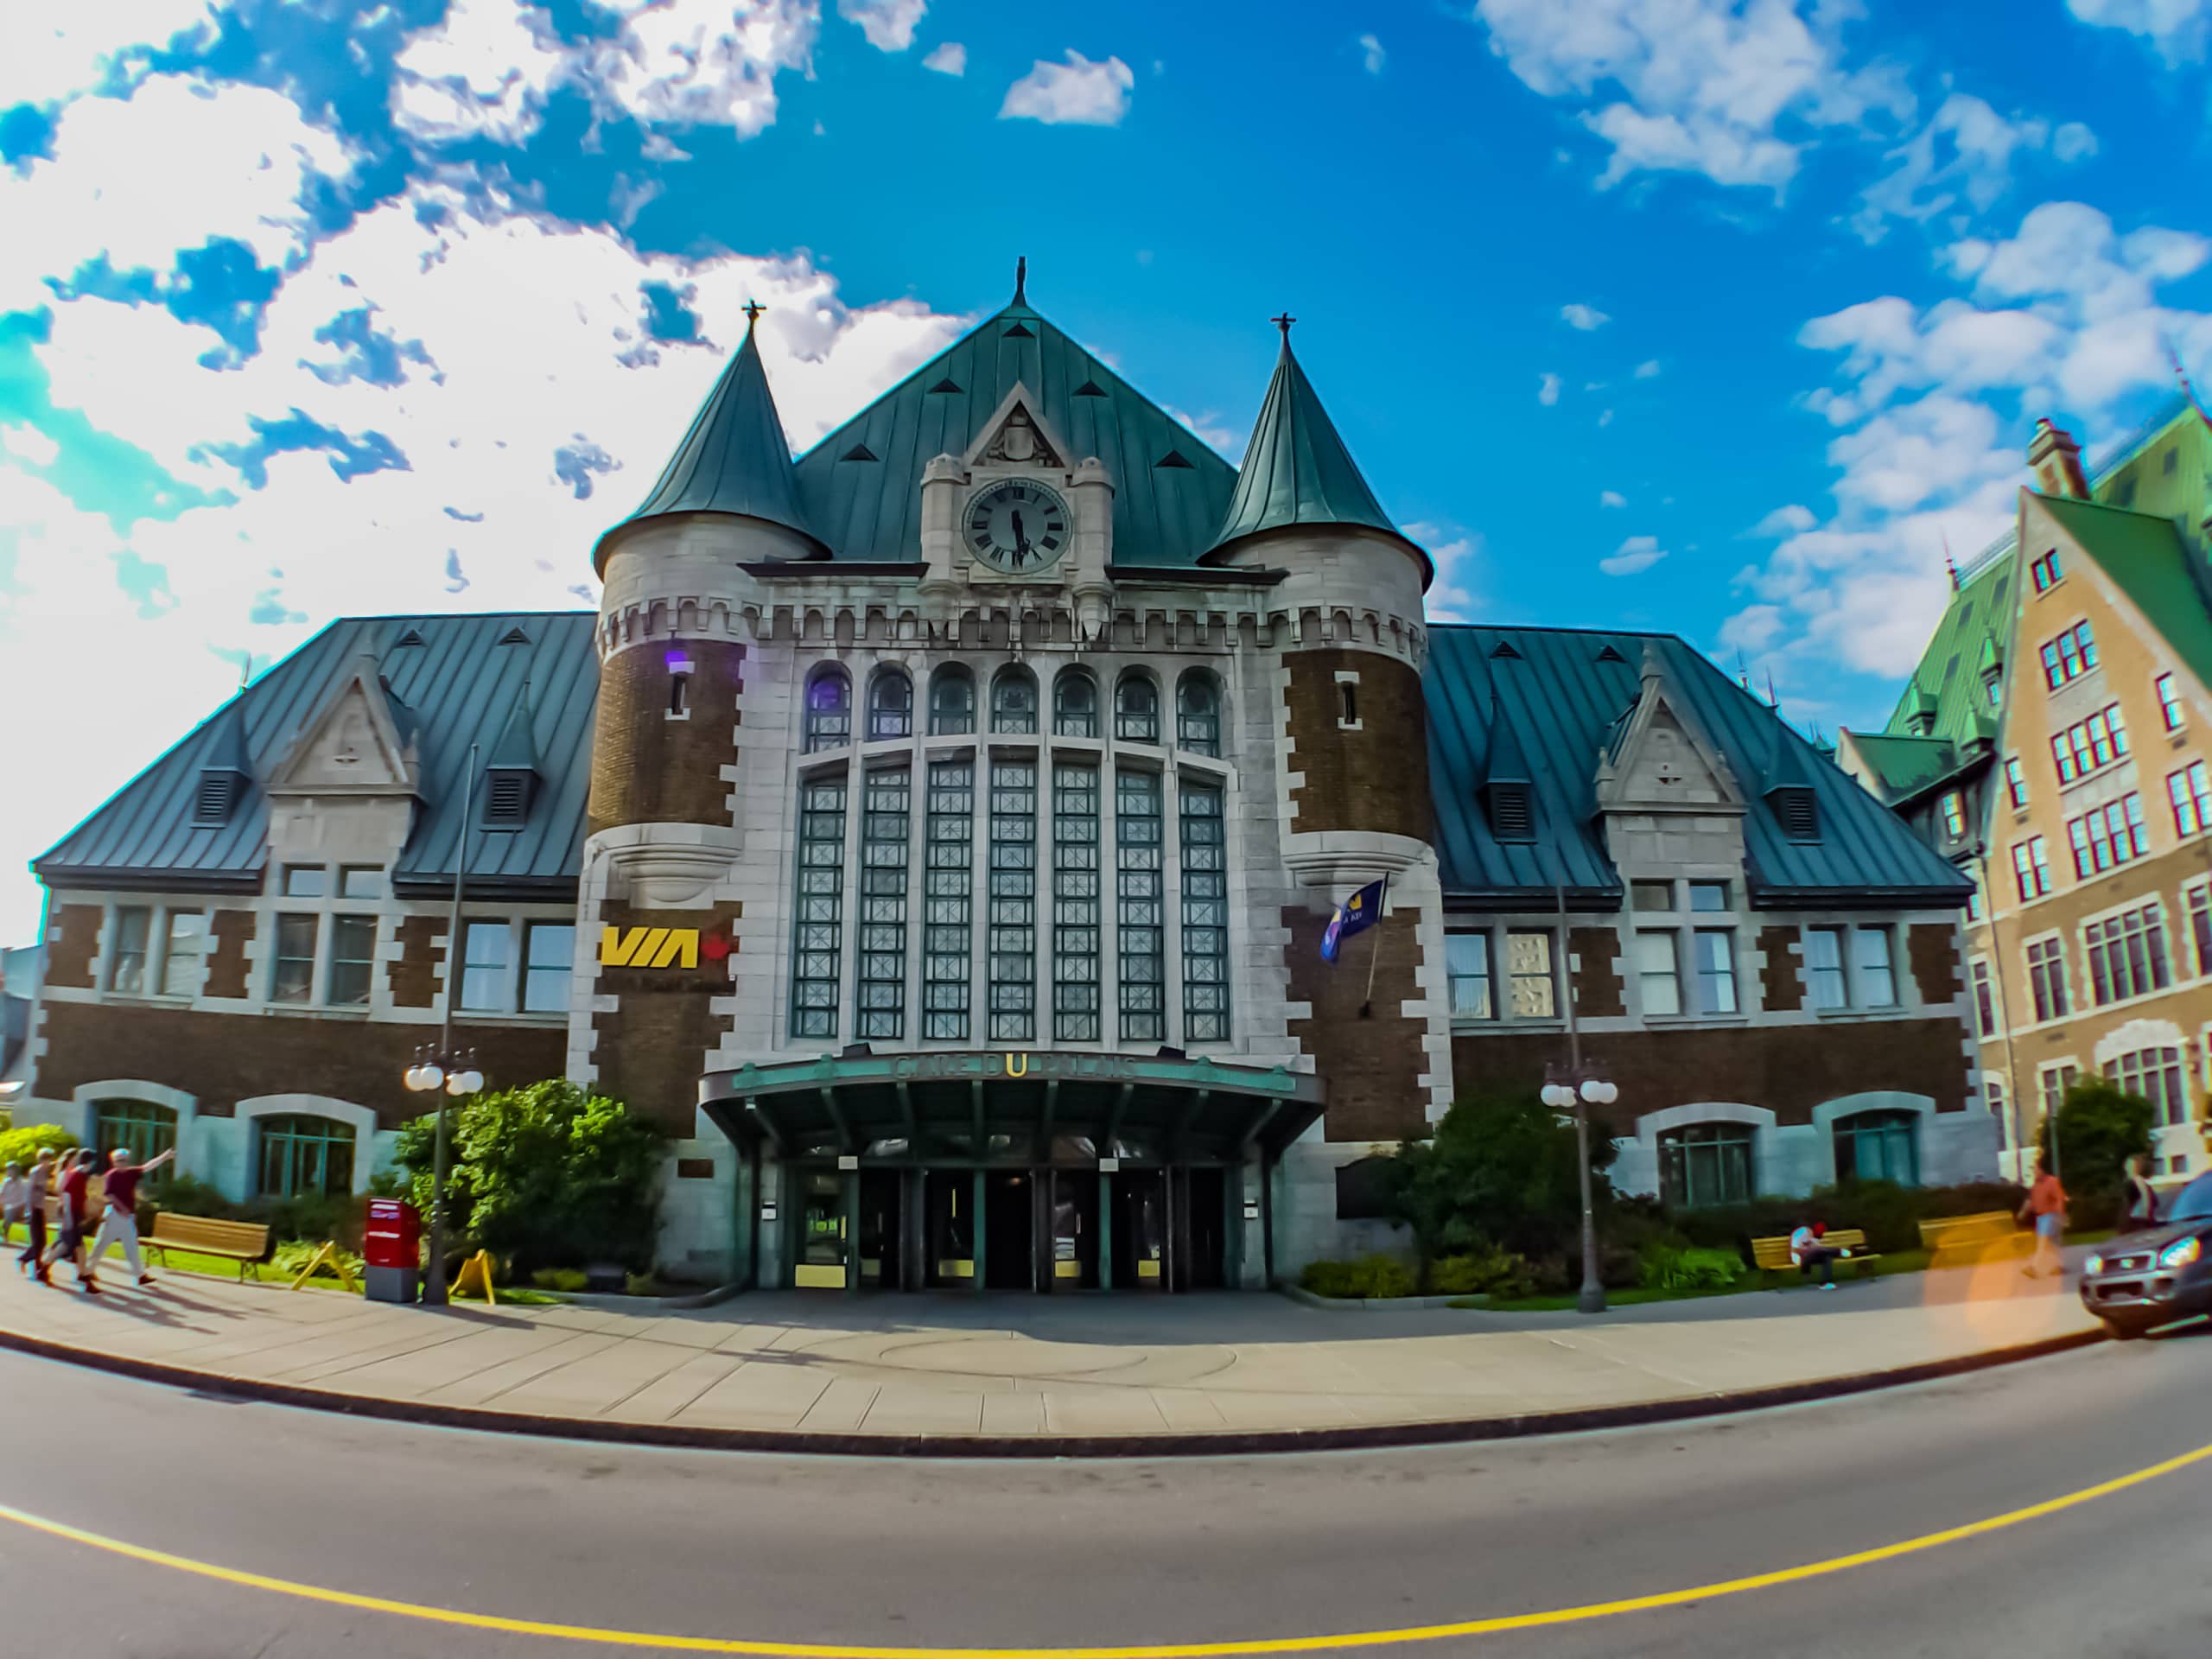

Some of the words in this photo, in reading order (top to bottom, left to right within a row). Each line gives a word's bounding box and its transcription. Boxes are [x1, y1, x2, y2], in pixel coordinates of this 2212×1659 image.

[601, 926, 699, 969] VIA
[893, 1053, 969, 1078] GARE
[982, 1052, 1027, 1077] DU
[1040, 1053, 1136, 1079] PALAIS
